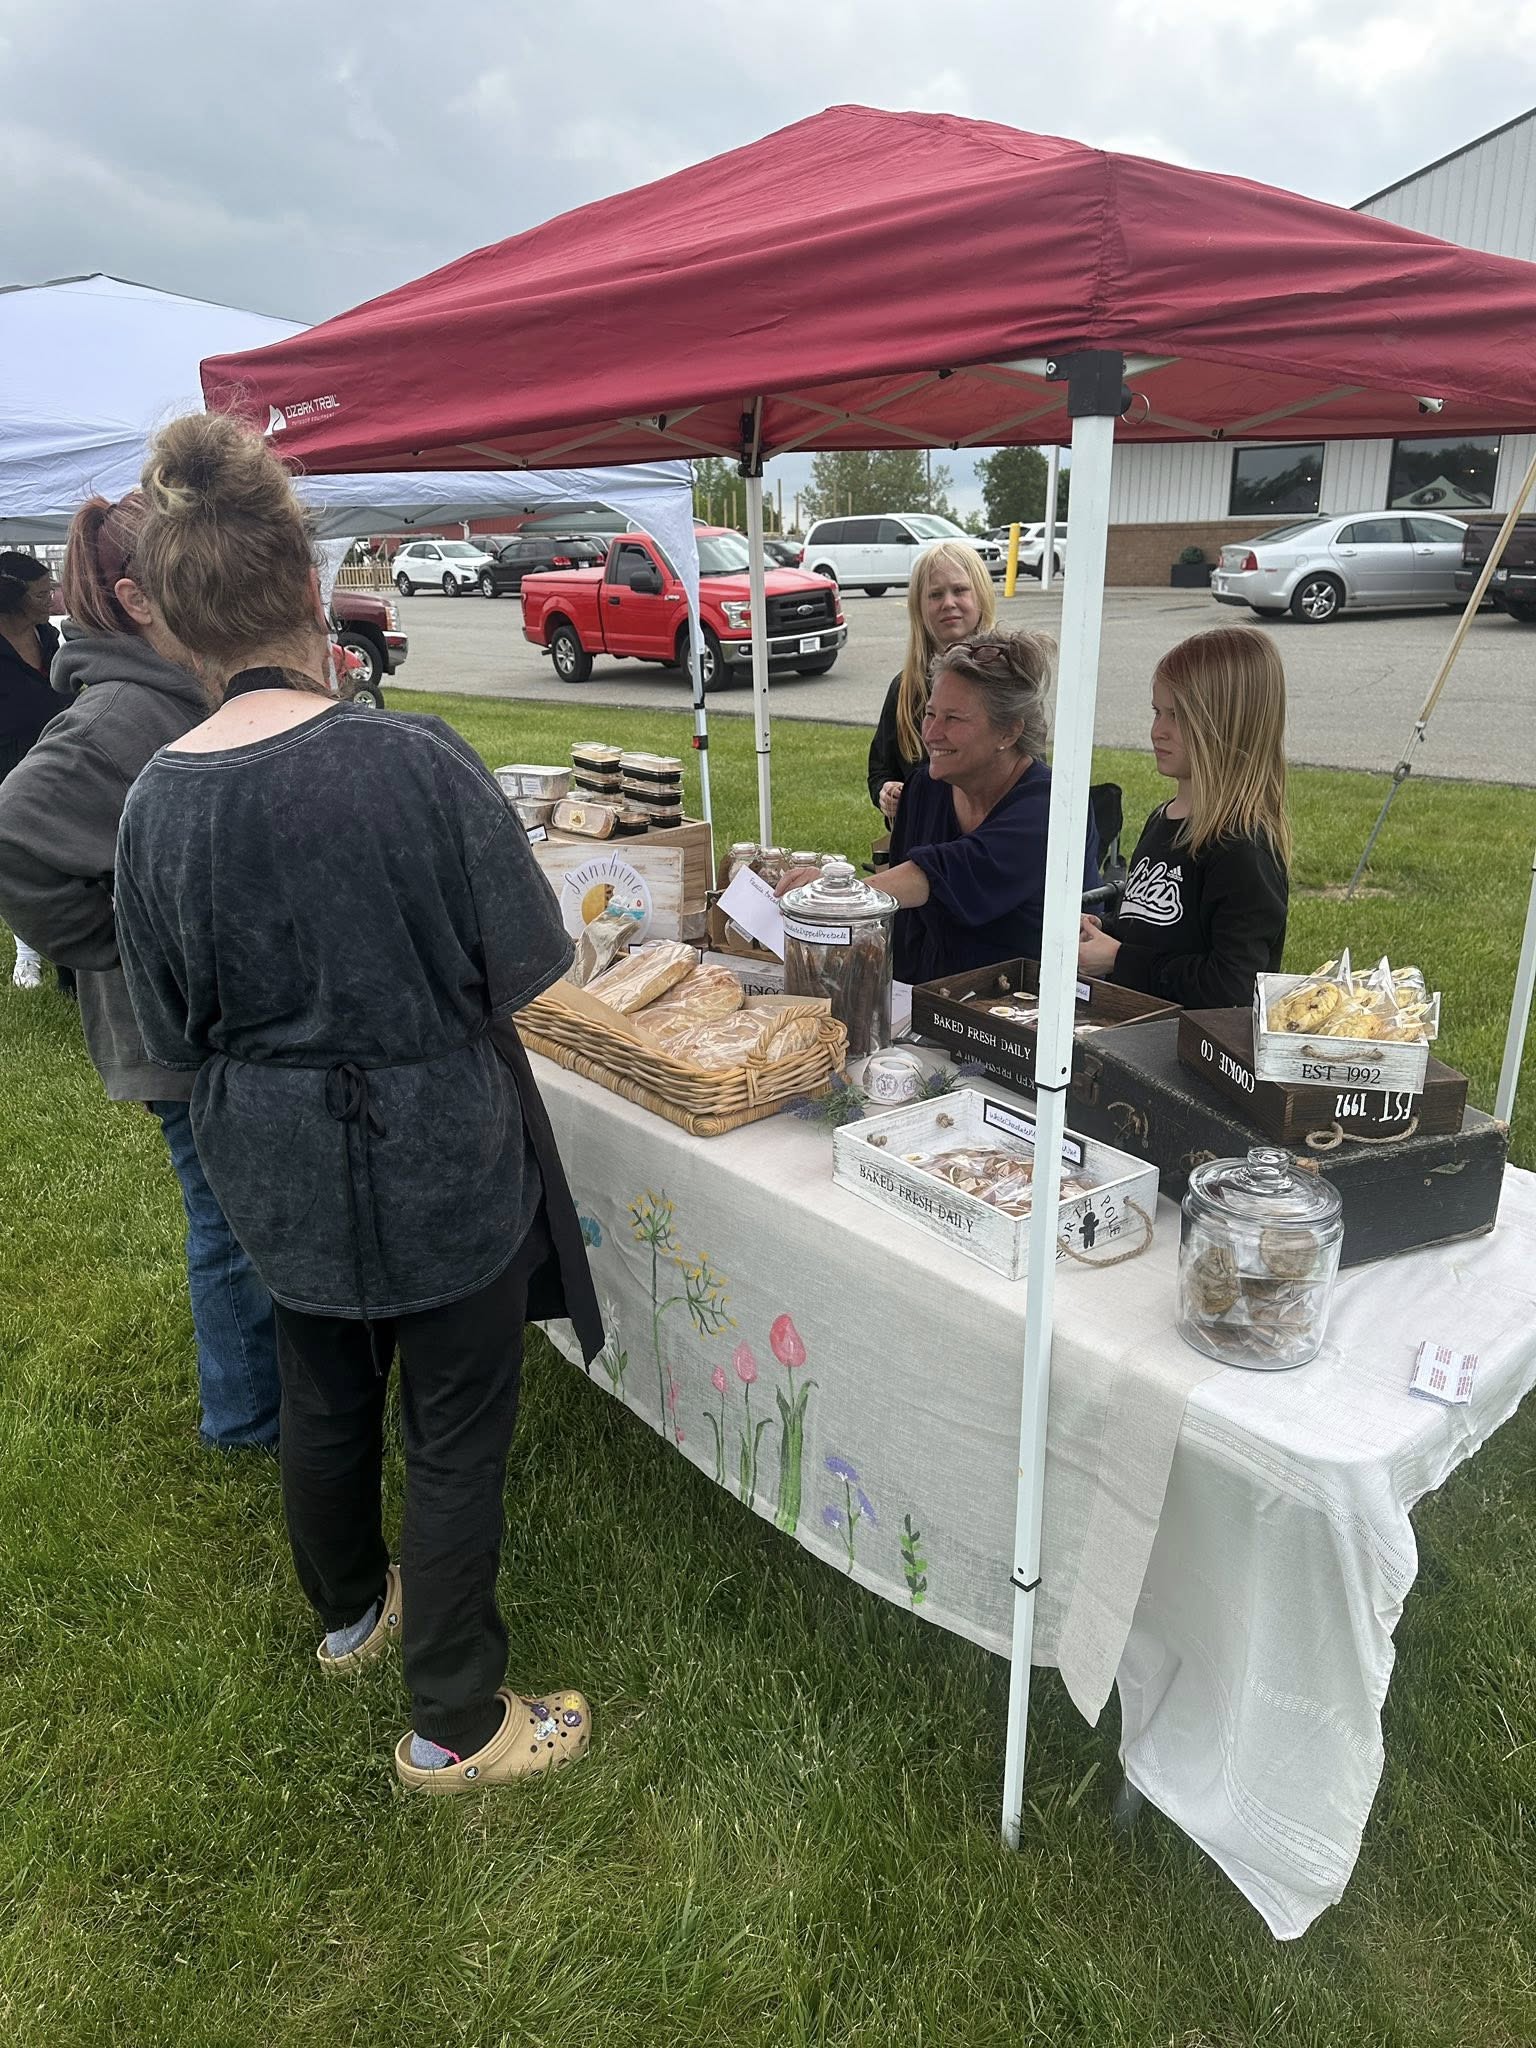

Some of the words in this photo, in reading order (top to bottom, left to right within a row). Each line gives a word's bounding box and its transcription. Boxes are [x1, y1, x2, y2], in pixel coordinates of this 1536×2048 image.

[564, 852, 644, 895] Sunshine
[933, 1013, 964, 1034] BAKED
[967, 1026, 997, 1047] FRESH
[1001, 1039, 1031, 1060] DAILY
[1201, 1039, 1214, 1062] CO
[1219, 1051, 1255, 1093] COOKIE
[1302, 1064, 1336, 1081] EST
[1347, 1066, 1381, 1084] 1992
[1335, 1093, 1367, 1118] 1992
[859, 1164, 894, 1192] BAKED
[899, 1185, 932, 1213] FRESH
[938, 1205, 974, 1233] DAILY
[1101, 1195, 1121, 1237] POLE
